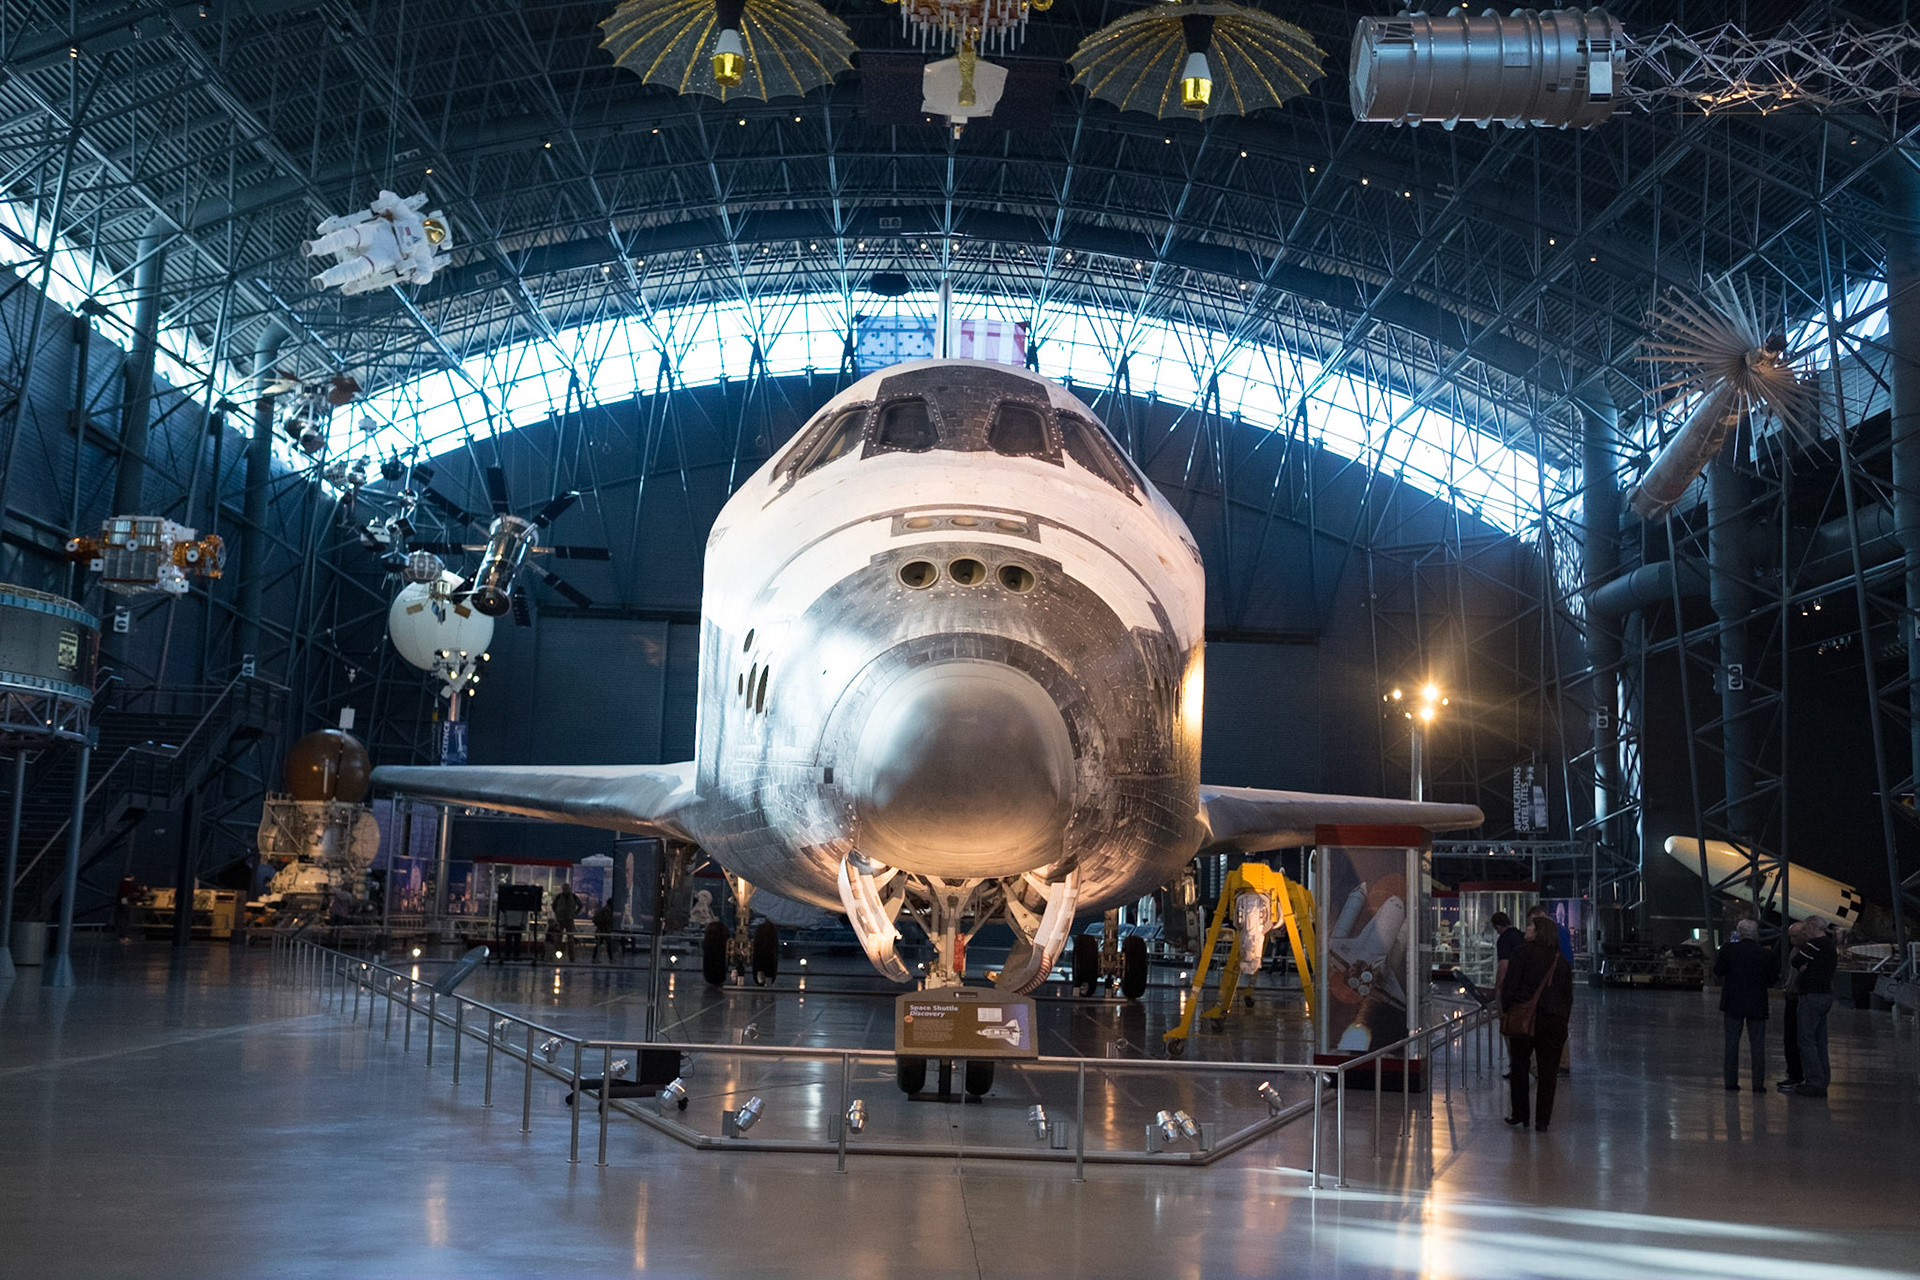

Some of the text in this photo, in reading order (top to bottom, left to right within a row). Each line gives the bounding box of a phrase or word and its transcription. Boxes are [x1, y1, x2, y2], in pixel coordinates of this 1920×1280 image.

[441, 721, 450, 759] SCIENCE
[1513, 766, 1521, 831] APPLICATIONS
[1521, 782, 1529, 831] SATELLITES
